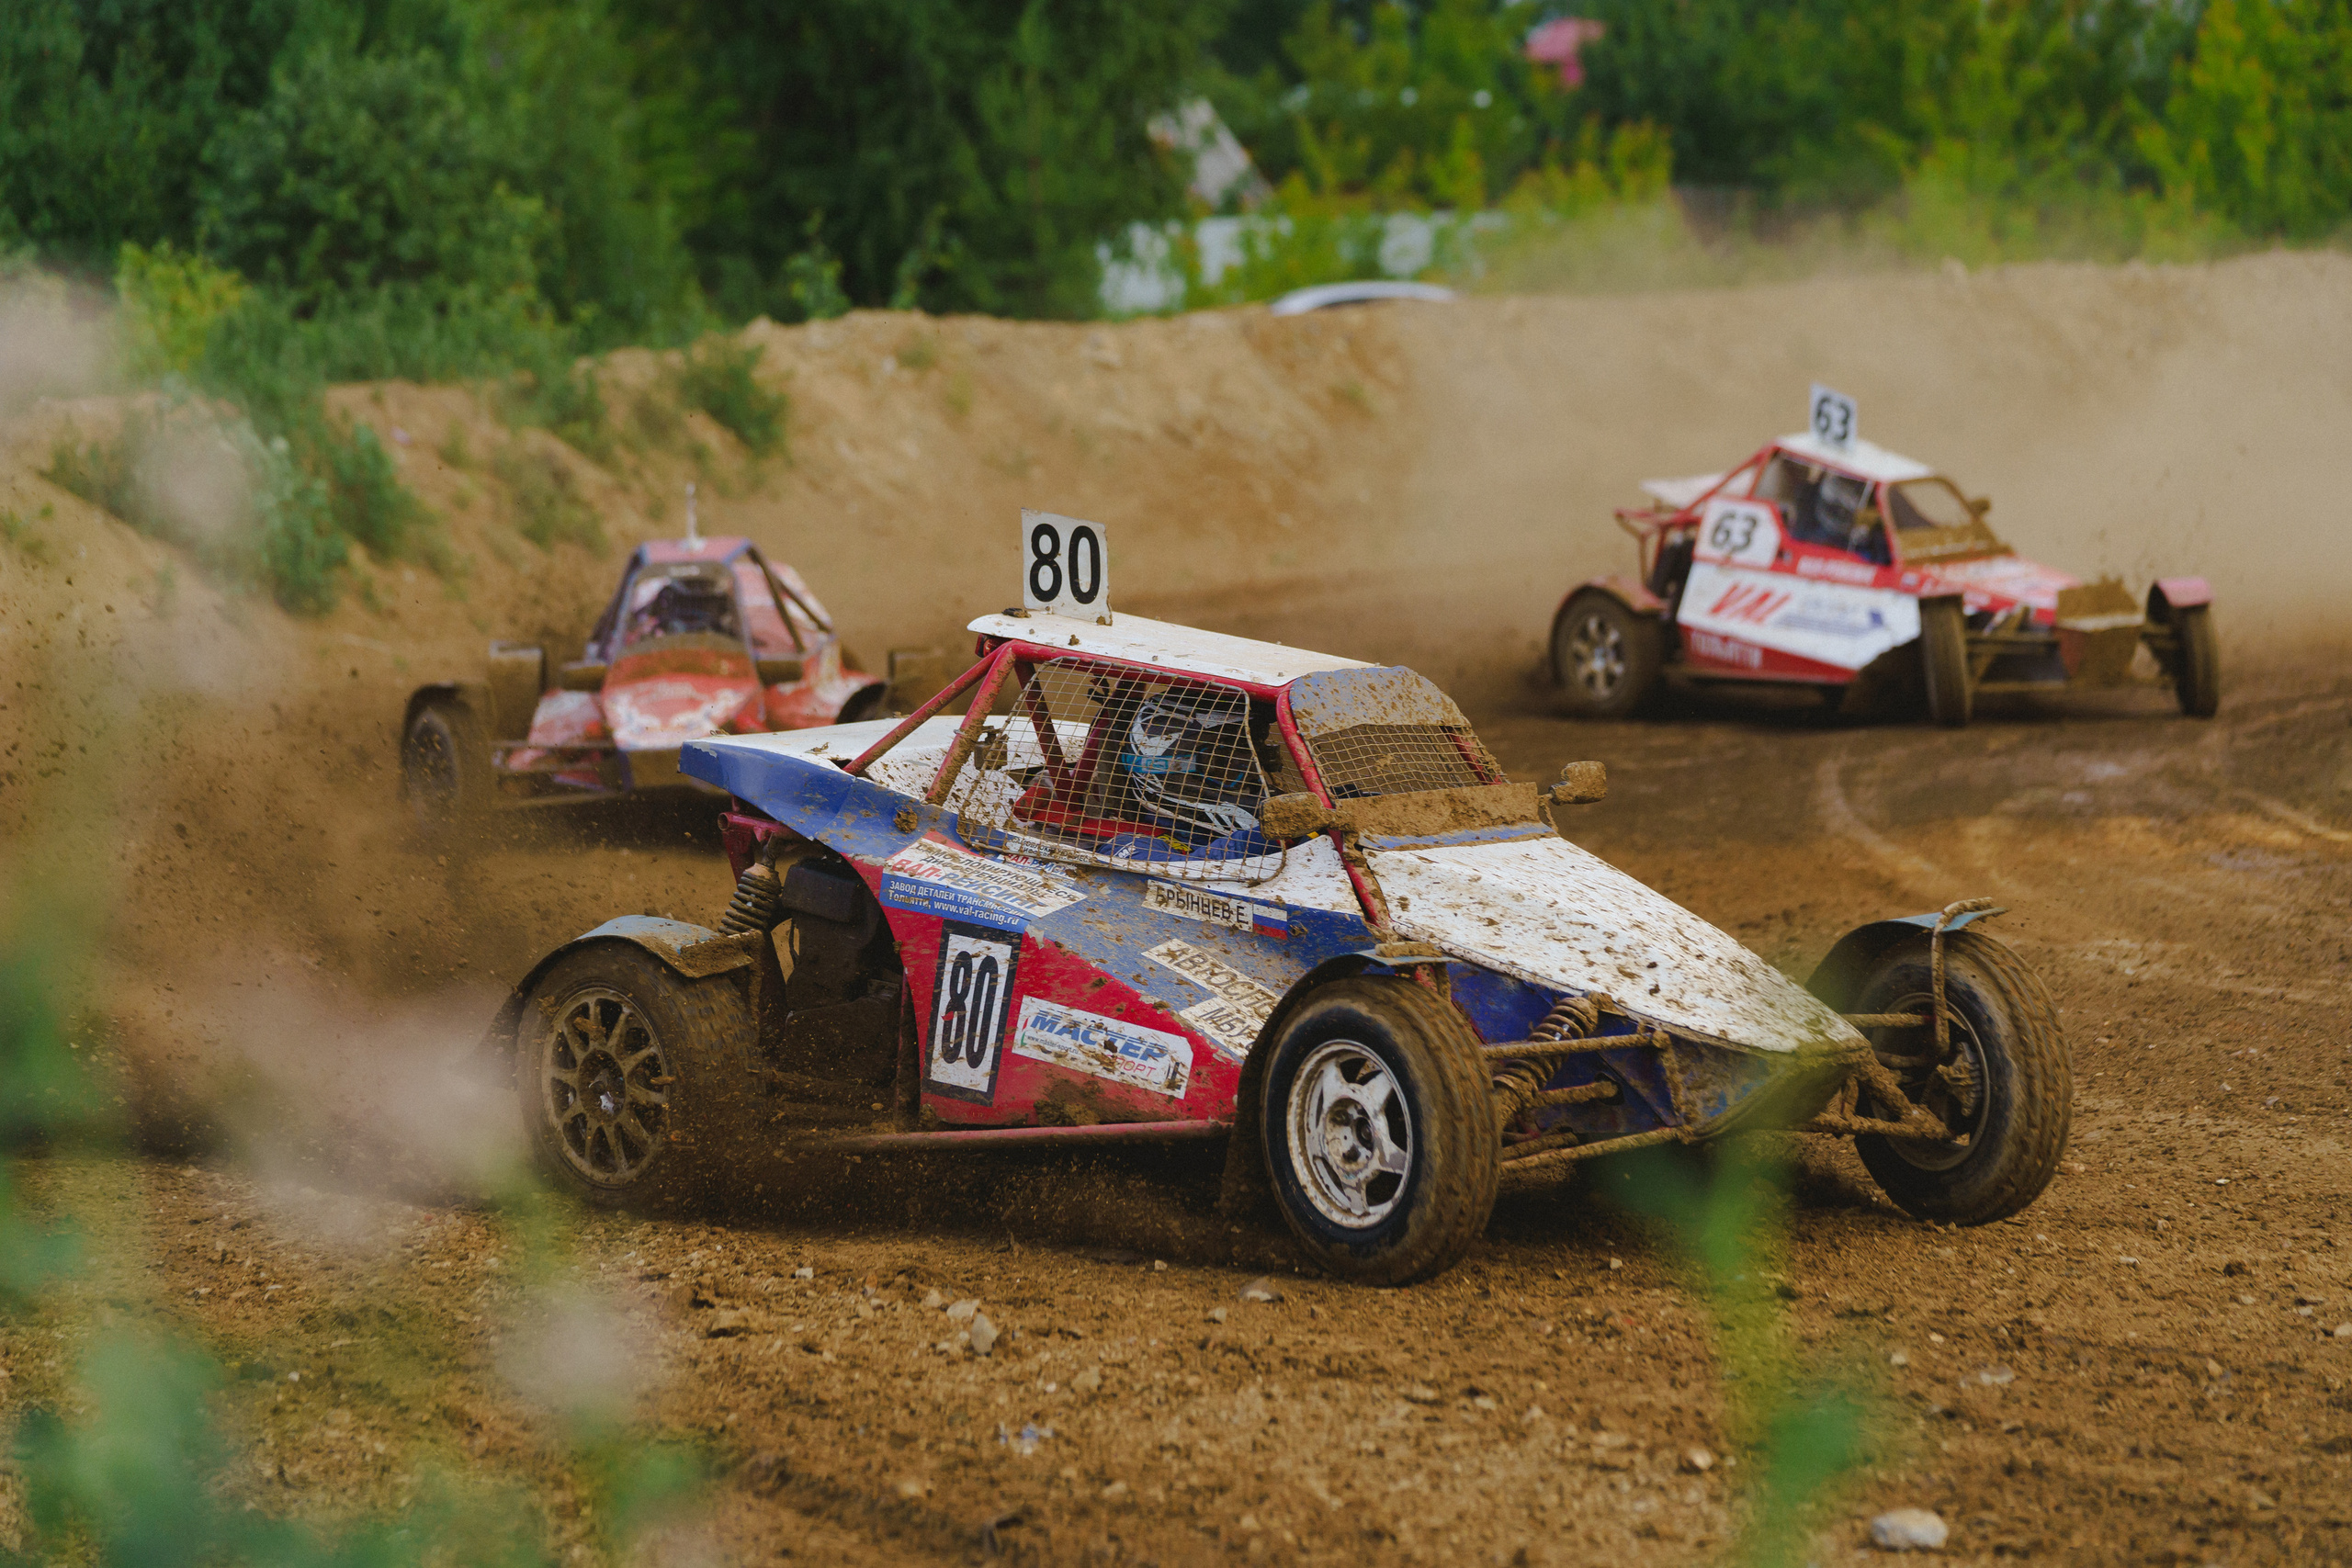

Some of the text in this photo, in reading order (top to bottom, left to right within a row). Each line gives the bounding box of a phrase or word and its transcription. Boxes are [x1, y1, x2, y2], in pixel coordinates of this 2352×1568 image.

[1815, 395, 1851, 442] 63
[1711, 511, 1758, 552] 63
[1030, 523, 1101, 605] 80
[889, 880, 1025, 917] ЗАВОД ДЕТАЛЕЙ ТРАНСМИССИИ
[891, 859, 1048, 909] ВАЛ-РЕЙСИНГ
[1155, 886, 1231, 920] БРЫНЦЕВ
[933, 900, 1020, 926] www.val-racing.ru
[941, 951, 999, 1069] 80
[1030, 1010, 1169, 1061] МАСТЕР
[1105, 1054, 1157, 1077] ПОРТ
